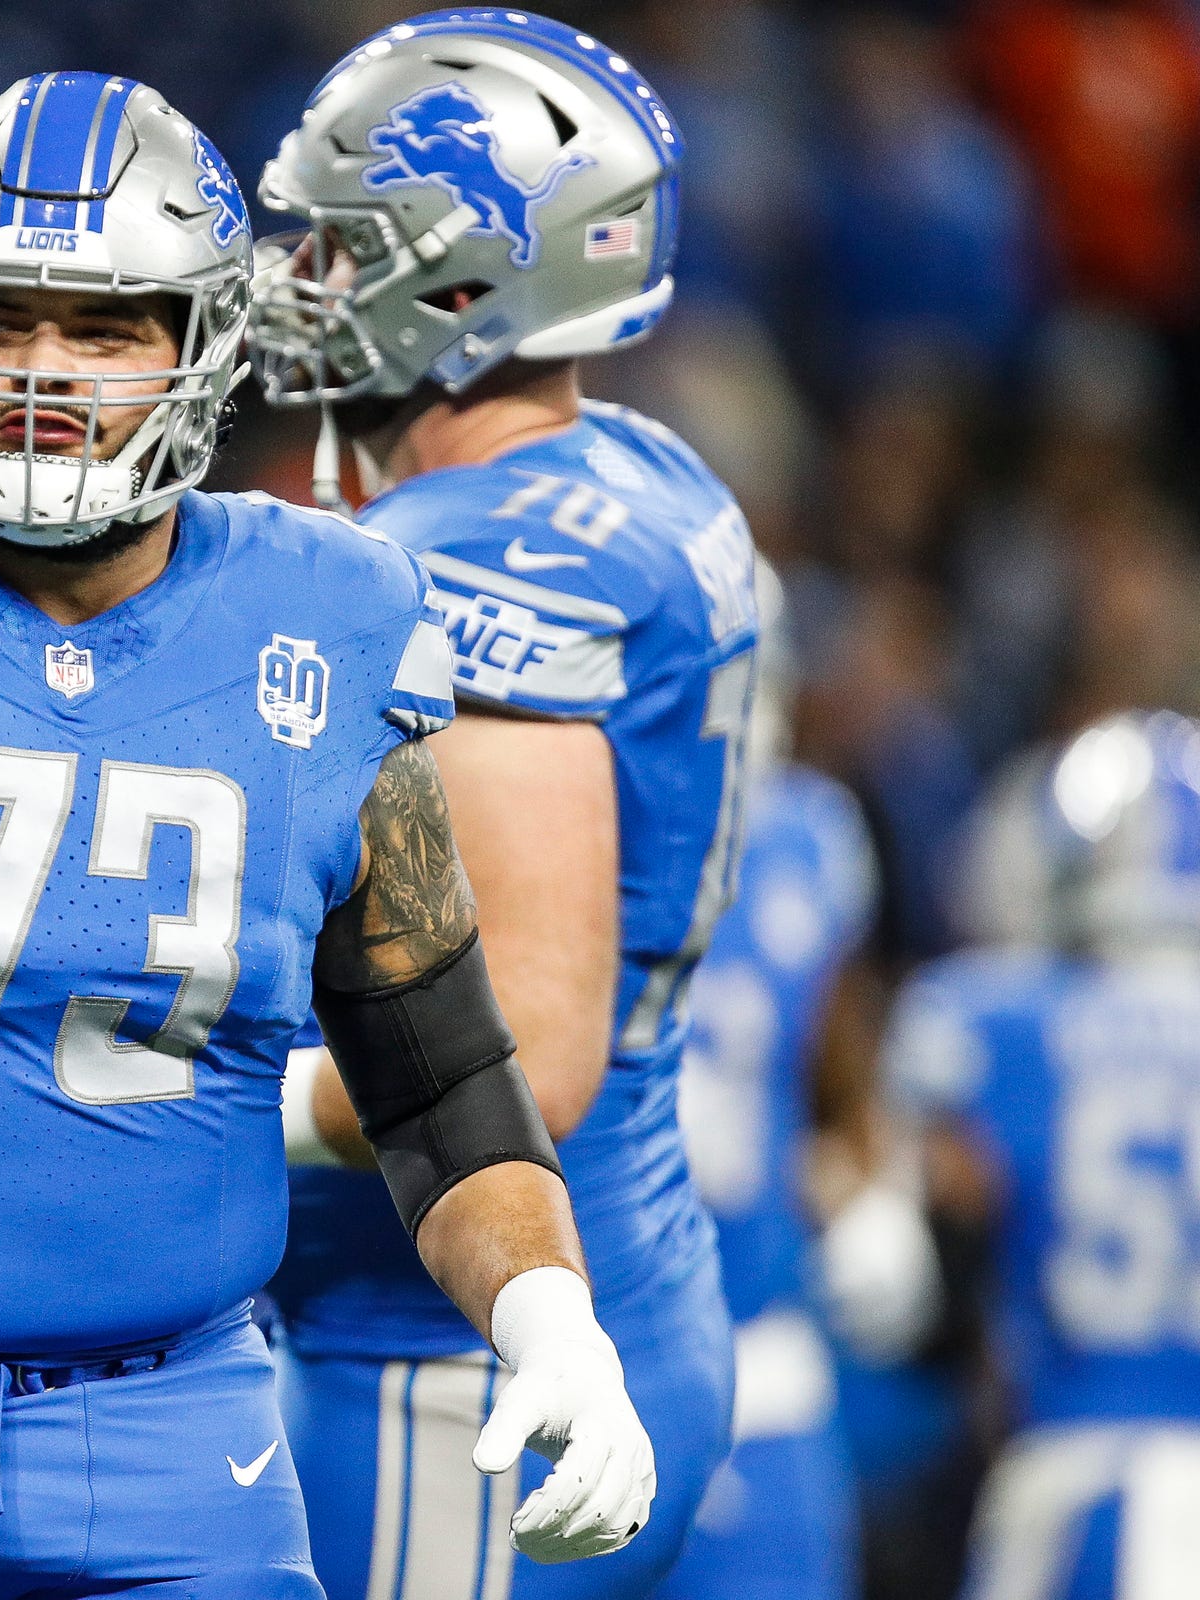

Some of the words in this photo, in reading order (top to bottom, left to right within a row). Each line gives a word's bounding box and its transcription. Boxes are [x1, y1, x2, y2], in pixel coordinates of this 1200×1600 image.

[16, 229, 79, 252] LIONS
[488, 466, 631, 549] 70
[55, 664, 85, 687] NFL
[265, 651, 325, 720] 90
